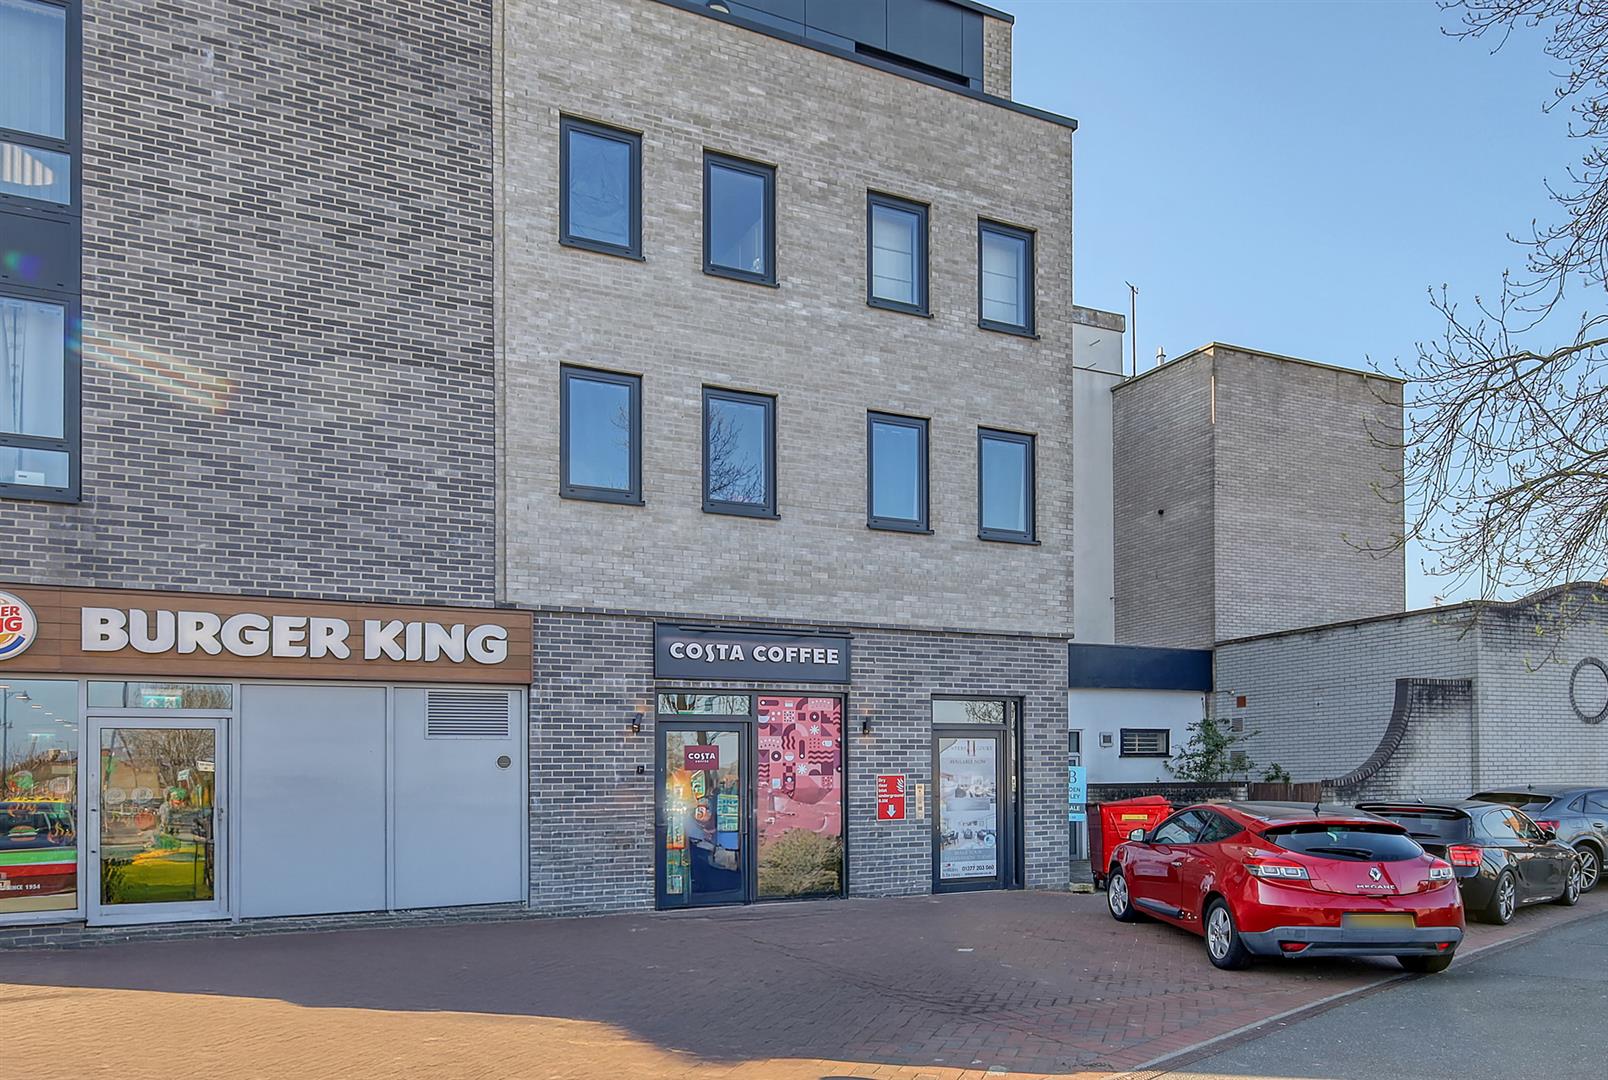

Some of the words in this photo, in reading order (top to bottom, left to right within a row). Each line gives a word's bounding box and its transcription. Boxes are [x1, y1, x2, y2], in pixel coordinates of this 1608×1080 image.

[82, 606, 352, 661] BURGER
[365, 619, 508, 665] KING
[669, 642, 745, 662] COSTA
[753, 645, 839, 664] COFFEE
[688, 752, 716, 761] COSTA
